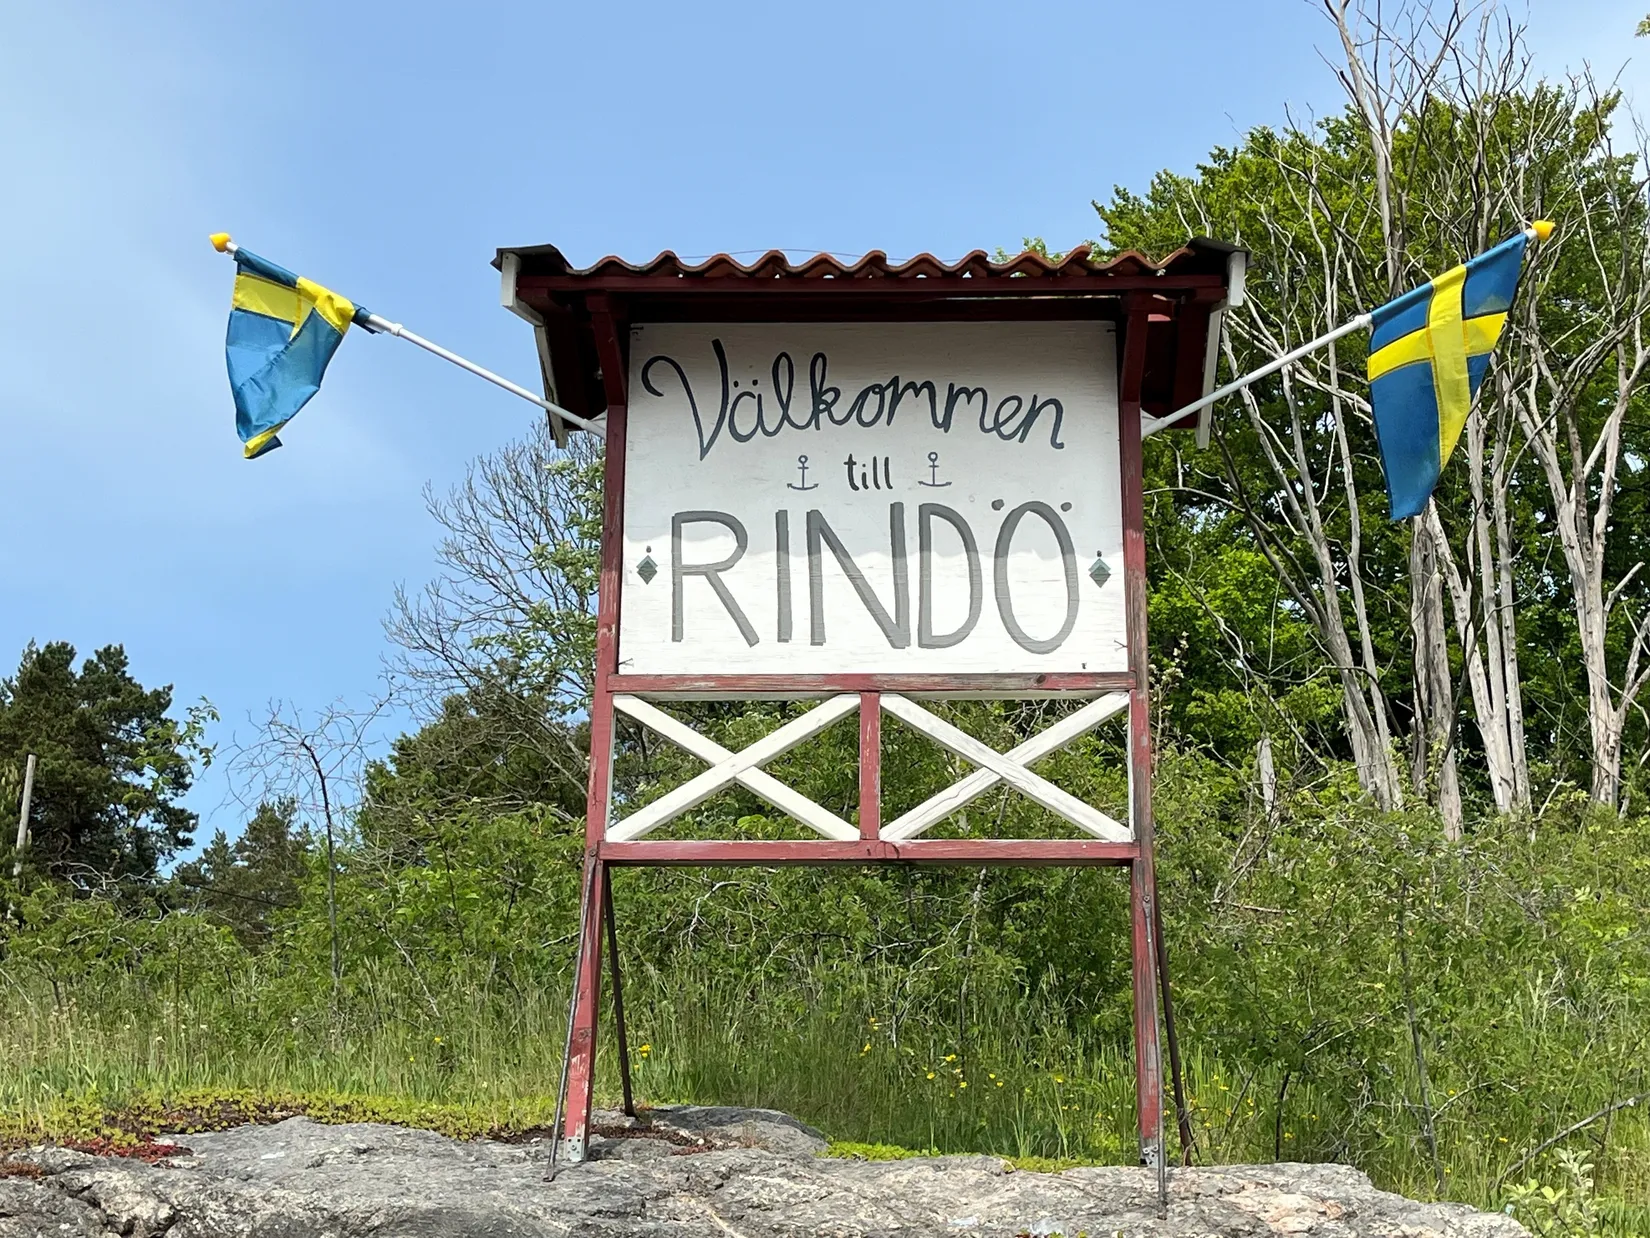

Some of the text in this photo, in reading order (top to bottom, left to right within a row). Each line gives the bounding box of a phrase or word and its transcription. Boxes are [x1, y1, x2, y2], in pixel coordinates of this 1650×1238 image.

[641, 338, 1065, 461] Välkommen
[843, 453, 894, 491] till
[671, 499, 1080, 655] RINDÖ
